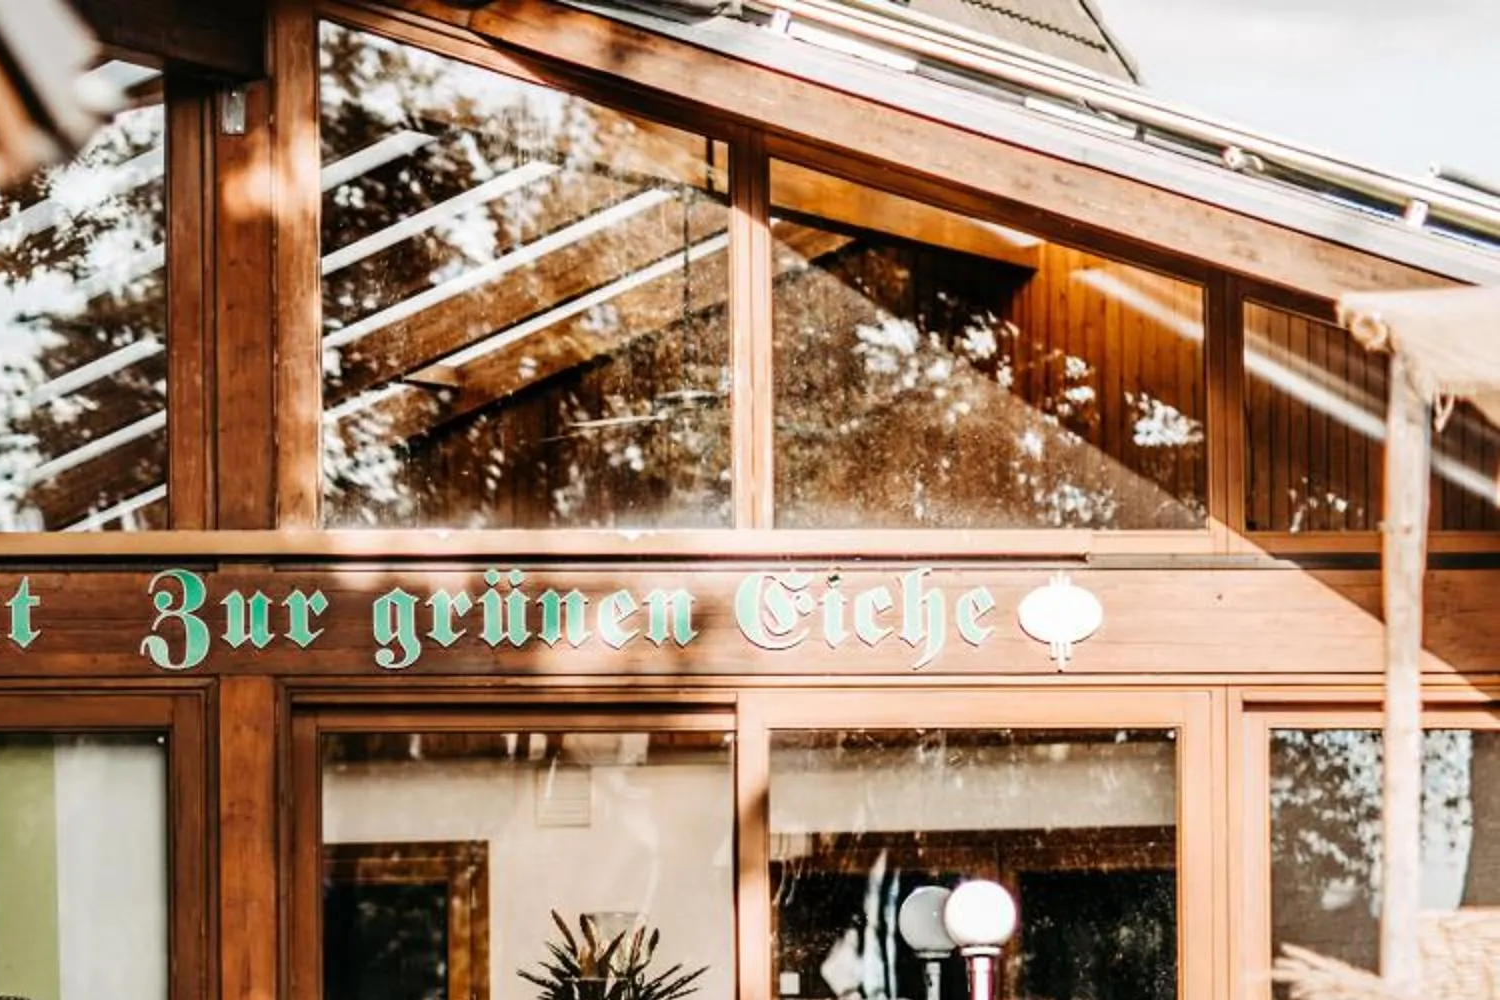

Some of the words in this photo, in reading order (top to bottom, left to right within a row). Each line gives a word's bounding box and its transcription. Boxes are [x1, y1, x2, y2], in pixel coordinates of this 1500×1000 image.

[140, 568, 329, 669] Zur
[373, 568, 699, 669] grünen
[735, 567, 996, 670] Eiche
